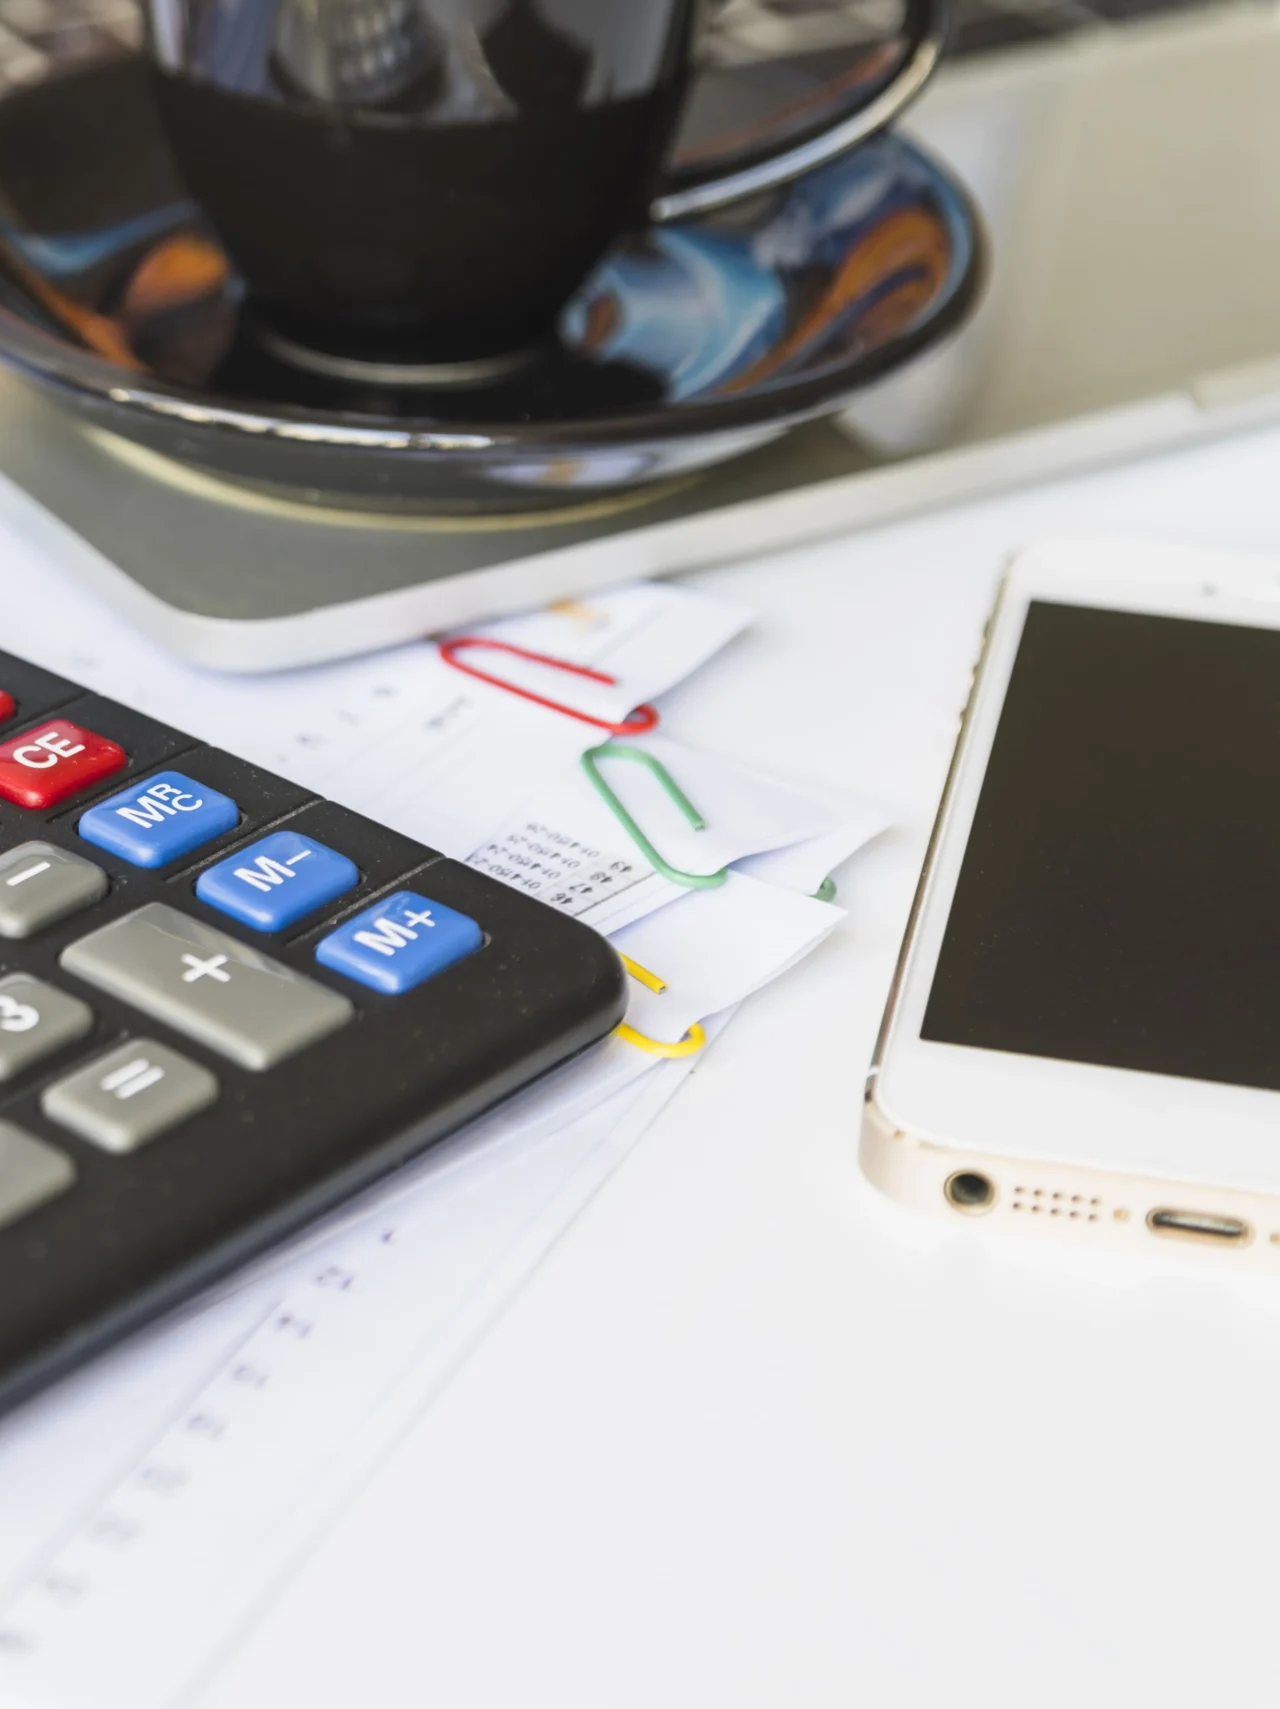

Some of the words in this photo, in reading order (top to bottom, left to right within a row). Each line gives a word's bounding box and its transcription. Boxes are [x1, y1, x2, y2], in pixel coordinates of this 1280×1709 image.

[12, 731, 86, 770] CE
[233, 849, 312, 892] M-
[353, 908, 436, 958] M+
[183, 955, 230, 982] +
